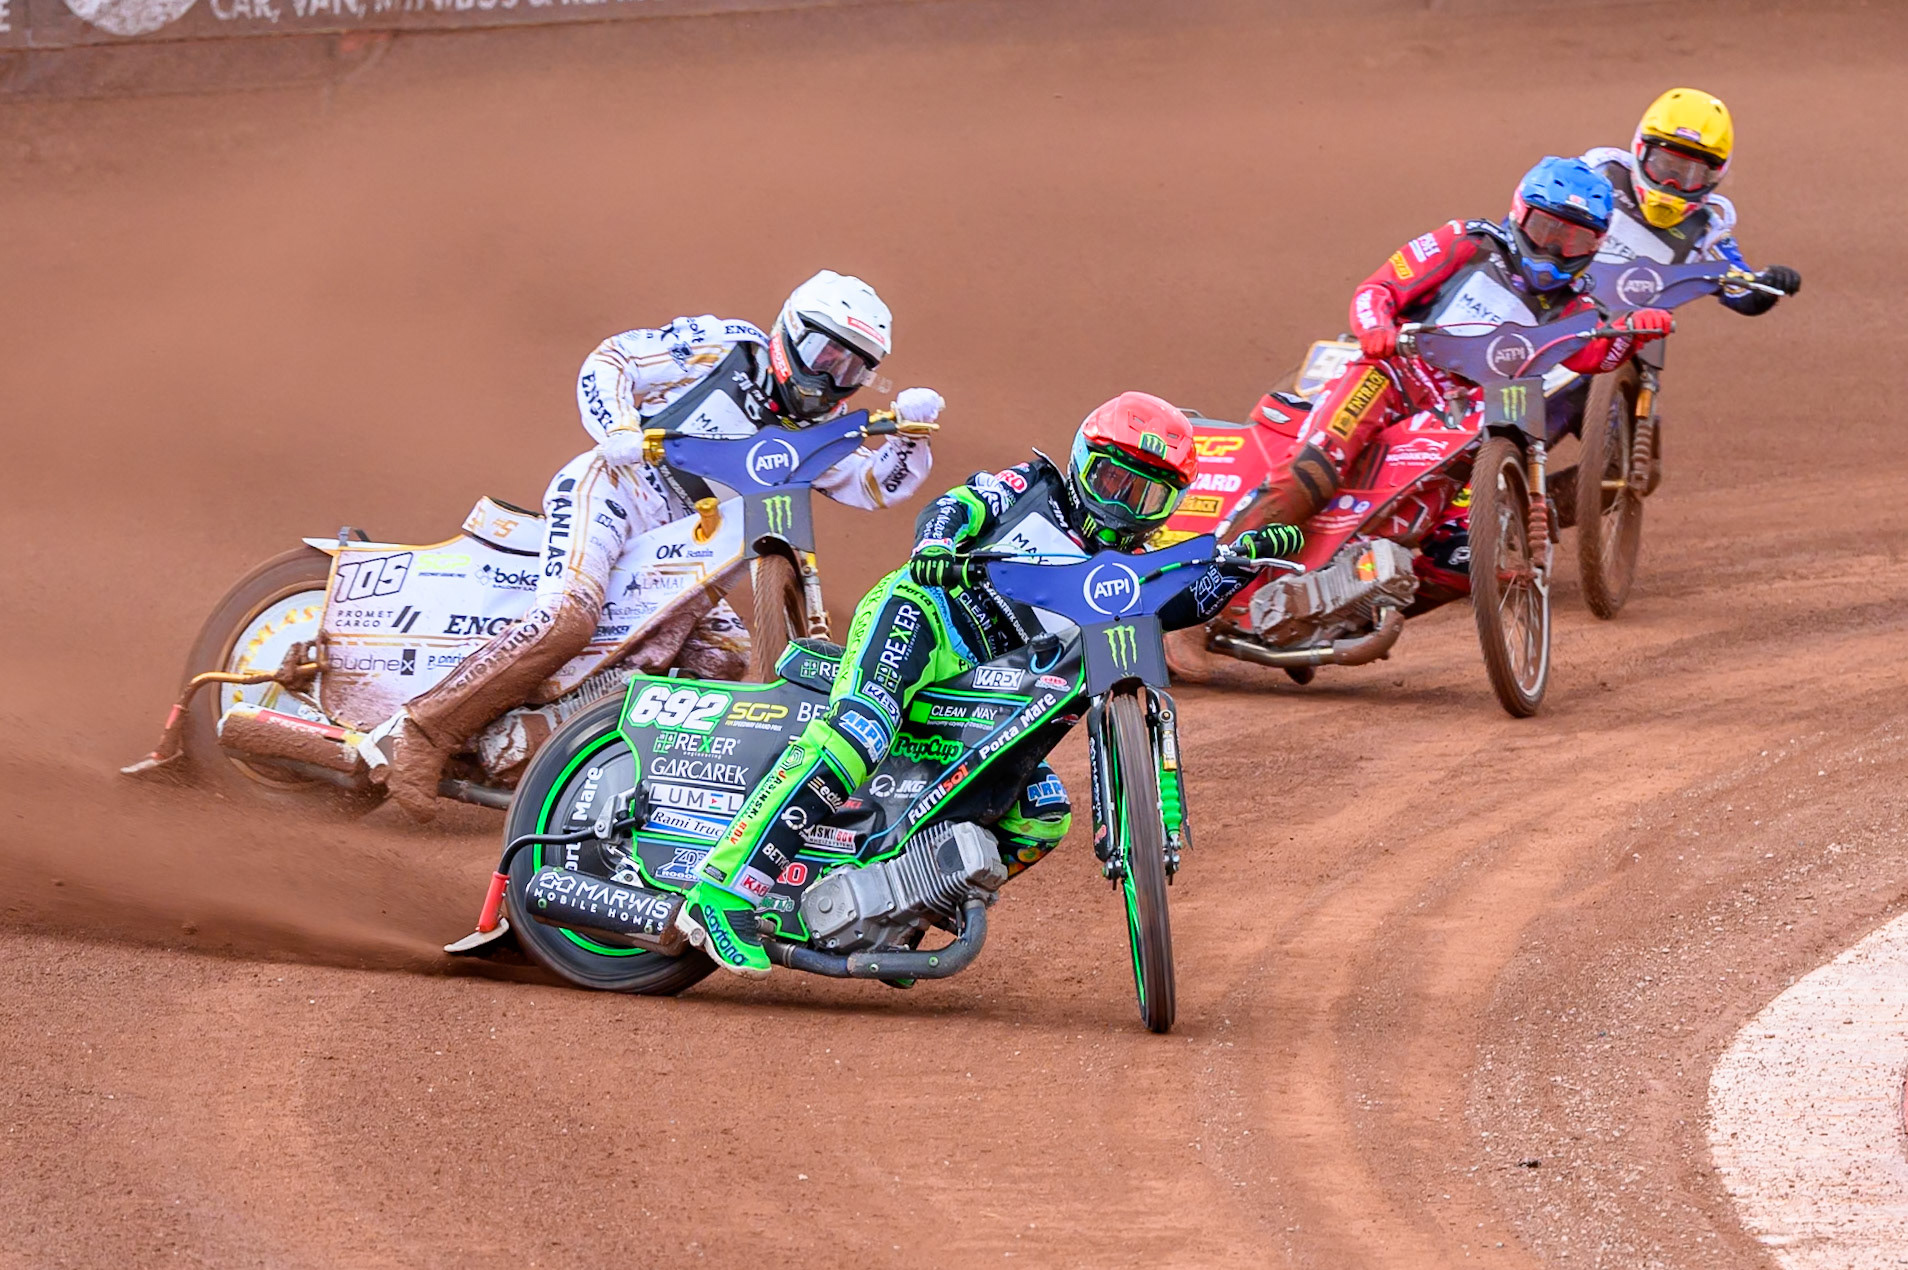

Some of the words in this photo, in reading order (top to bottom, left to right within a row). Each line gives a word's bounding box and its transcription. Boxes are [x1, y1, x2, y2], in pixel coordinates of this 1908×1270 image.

[755, 452, 790, 471] ATPI
[545, 498, 575, 577] ANLAS
[656, 544, 687, 560] OK
[335, 552, 414, 603] 105
[1094, 578, 1130, 599] ATPI
[335, 619, 381, 628] CARGO
[337, 610, 394, 618] PROMET
[960, 592, 992, 631] CLEAN
[993, 594, 1017, 622] PATRYK
[1012, 620, 1030, 644] DUDEK
[880, 604, 920, 669] REXER
[330, 654, 414, 671] budnex
[976, 670, 1022, 687] KAREX
[629, 685, 731, 731] 692
[727, 701, 789, 722] SGP
[931, 705, 967, 718] CLEAN
[971, 706, 998, 720] WAY
[978, 725, 1019, 760] Porta
[1020, 692, 1057, 728] Mare
[675, 733, 736, 755] REXER
[896, 735, 961, 763] PapCup
[650, 756, 750, 785] GARCAREK
[572, 767, 604, 821] Mare
[907, 764, 968, 825] Furnisol
[653, 811, 691, 829] Rami
[534, 889, 597, 913] MOBILE
[608, 909, 664, 931] HOMES
[576, 880, 672, 919] MARWIS
[704, 904, 748, 966] daytona
